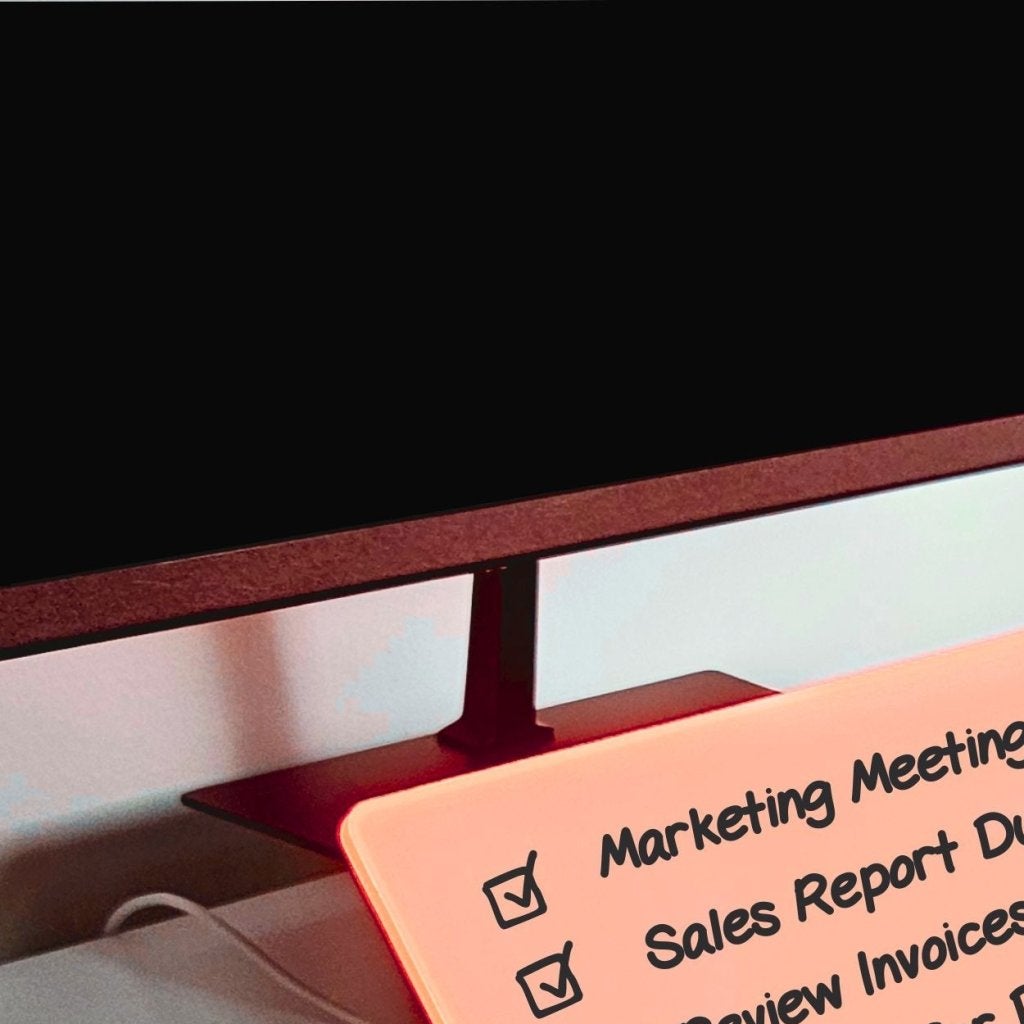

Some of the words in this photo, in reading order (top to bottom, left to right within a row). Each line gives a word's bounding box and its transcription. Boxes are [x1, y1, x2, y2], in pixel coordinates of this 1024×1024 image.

[600, 781, 835, 878] Marketing
[645, 902, 781, 969] Sales
[794, 830, 958, 922] Report
